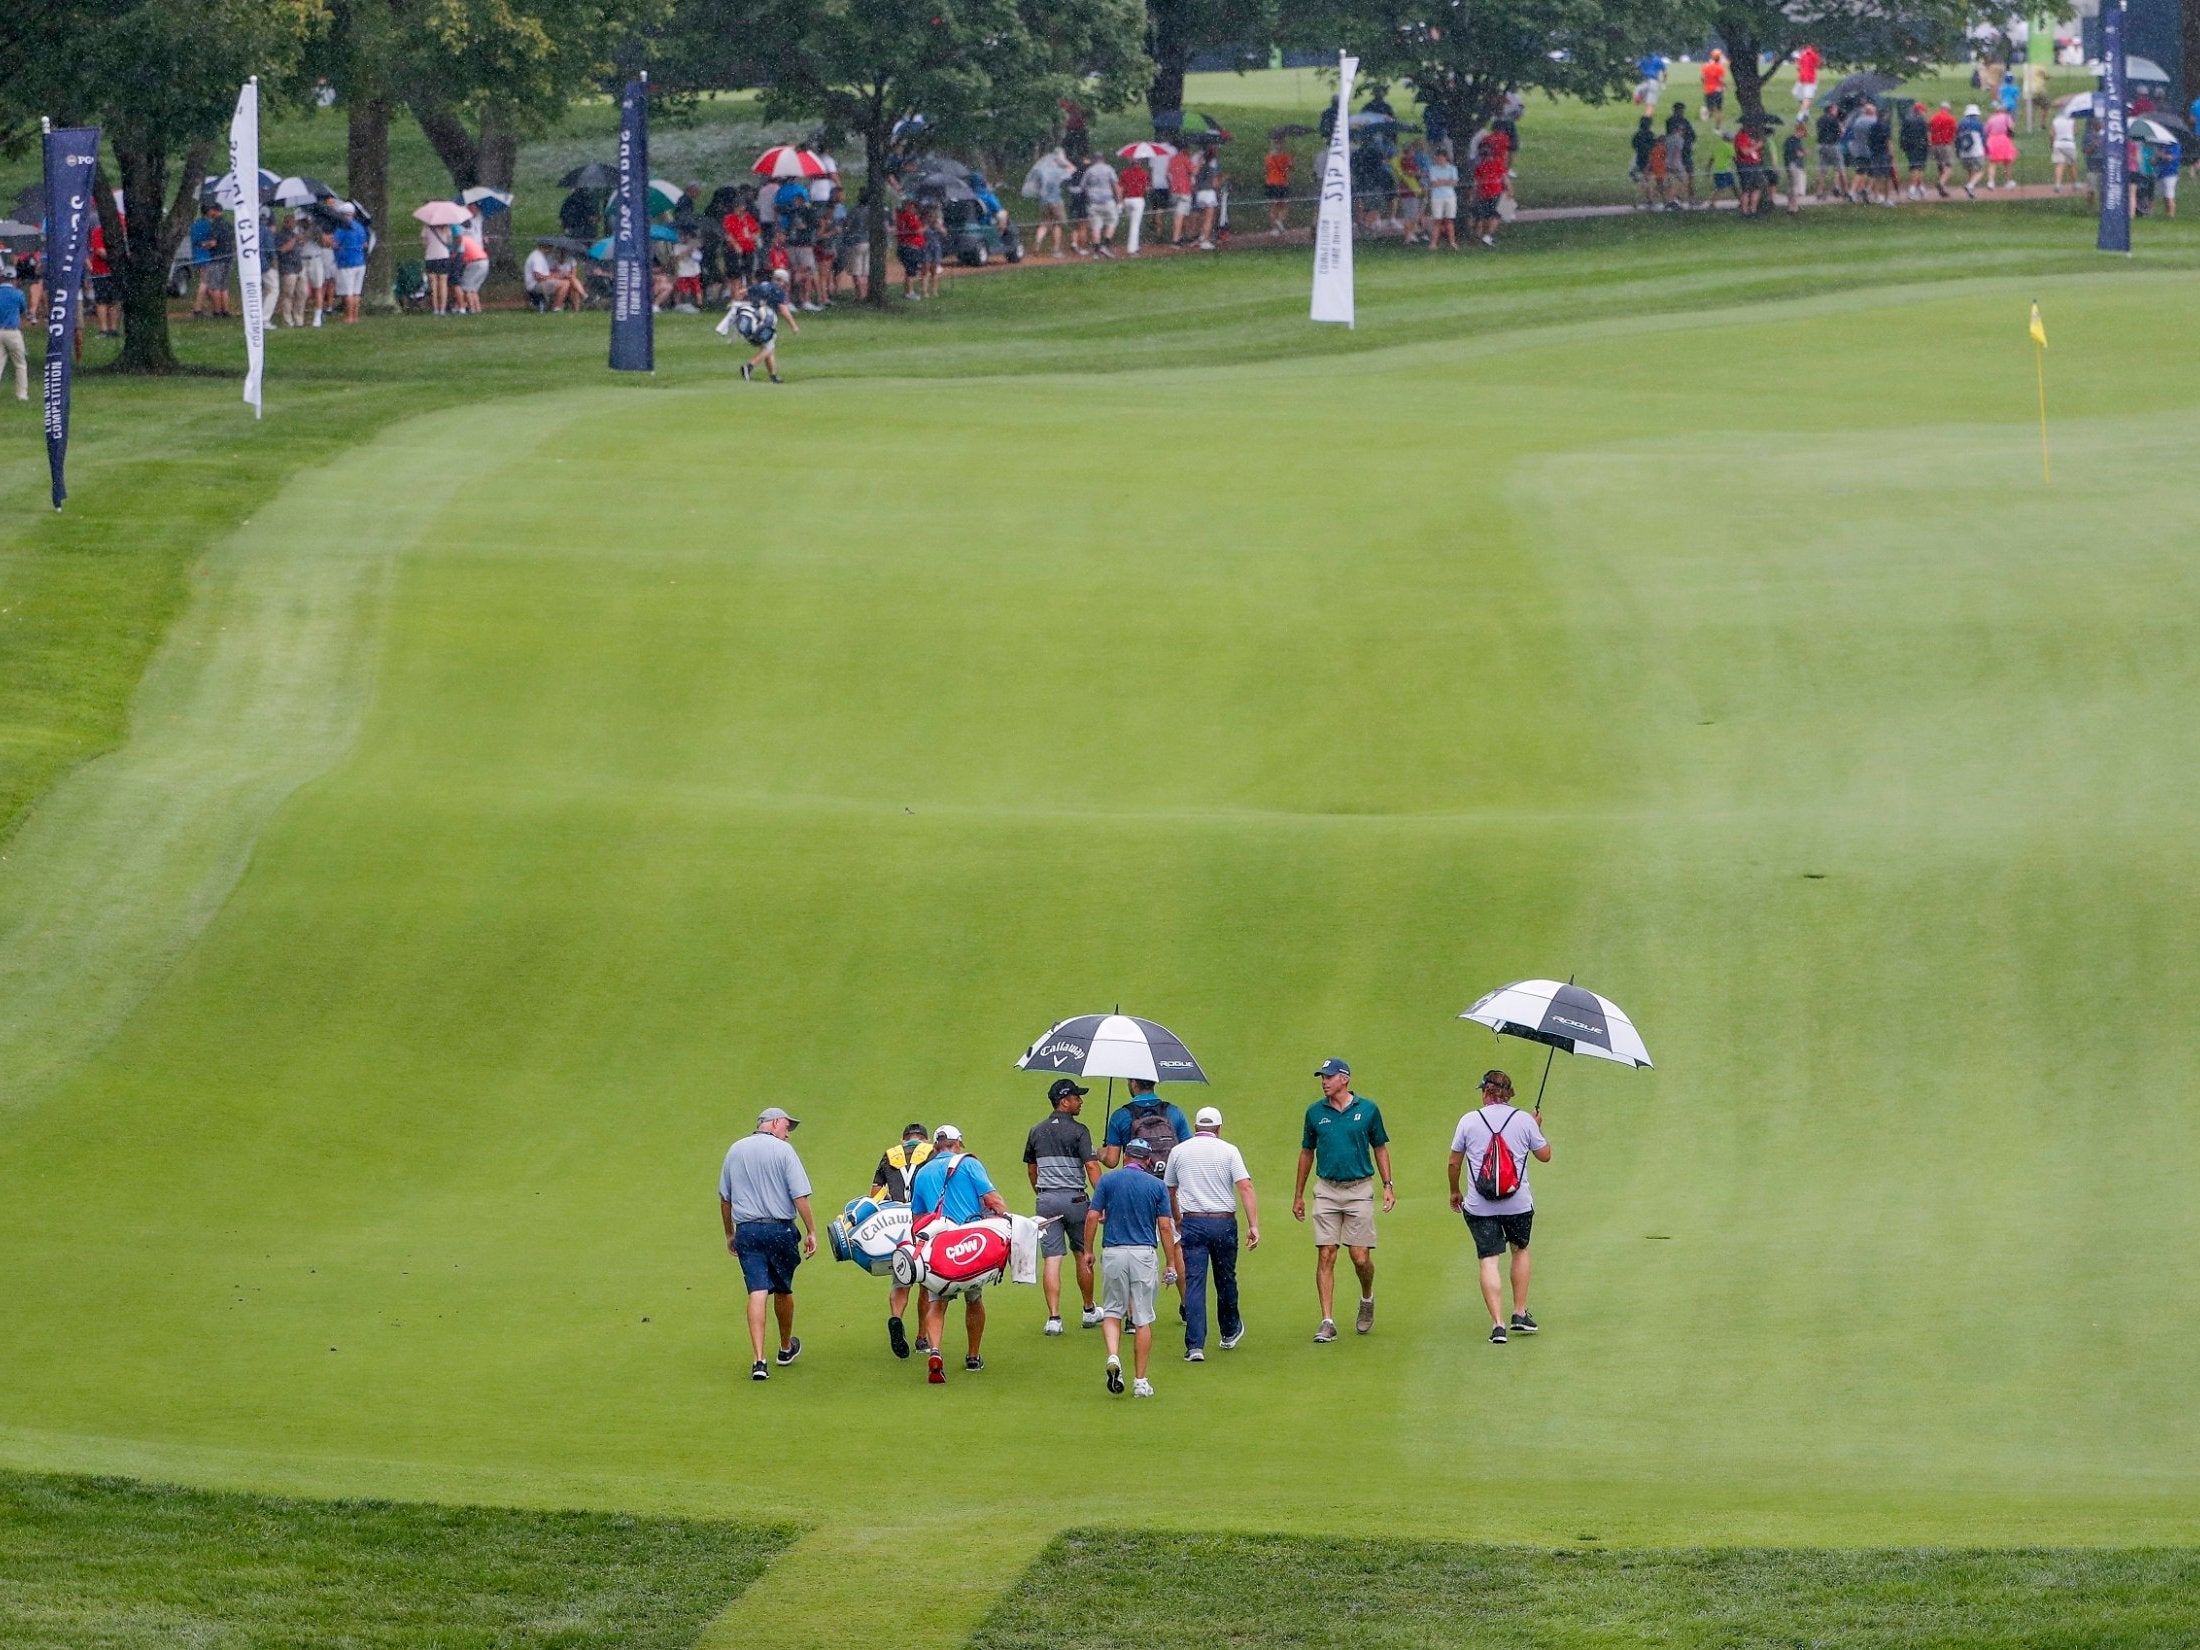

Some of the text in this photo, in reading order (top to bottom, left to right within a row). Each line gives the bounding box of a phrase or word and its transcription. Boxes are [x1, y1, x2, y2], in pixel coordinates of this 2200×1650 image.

[51, 361, 63, 439] COMPETITION
[1552, 1015, 1603, 1035] ROGUE
[1040, 1041, 1085, 1060] Callaway
[1158, 1060, 1194, 1068] ROGUE
[861, 1214, 912, 1241] Callaw
[945, 1239, 978, 1259] CDW
